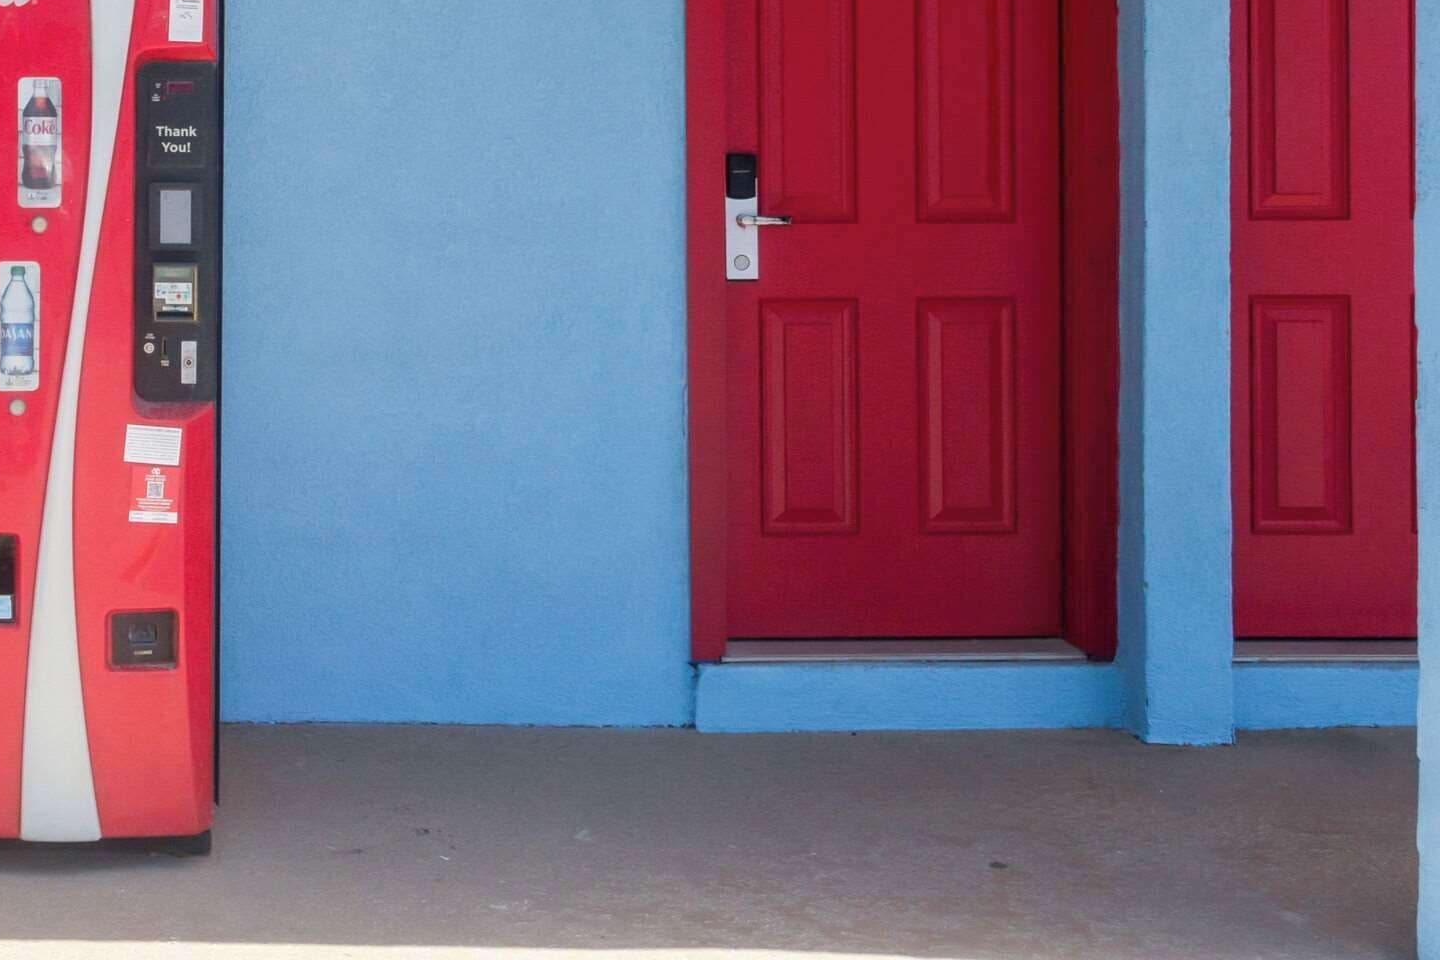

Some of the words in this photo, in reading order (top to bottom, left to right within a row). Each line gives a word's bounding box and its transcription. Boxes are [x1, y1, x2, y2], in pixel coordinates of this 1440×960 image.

[24, 119, 56, 135] Coke
[155, 125, 197, 137] Thank
[161, 142, 191, 153] You!
